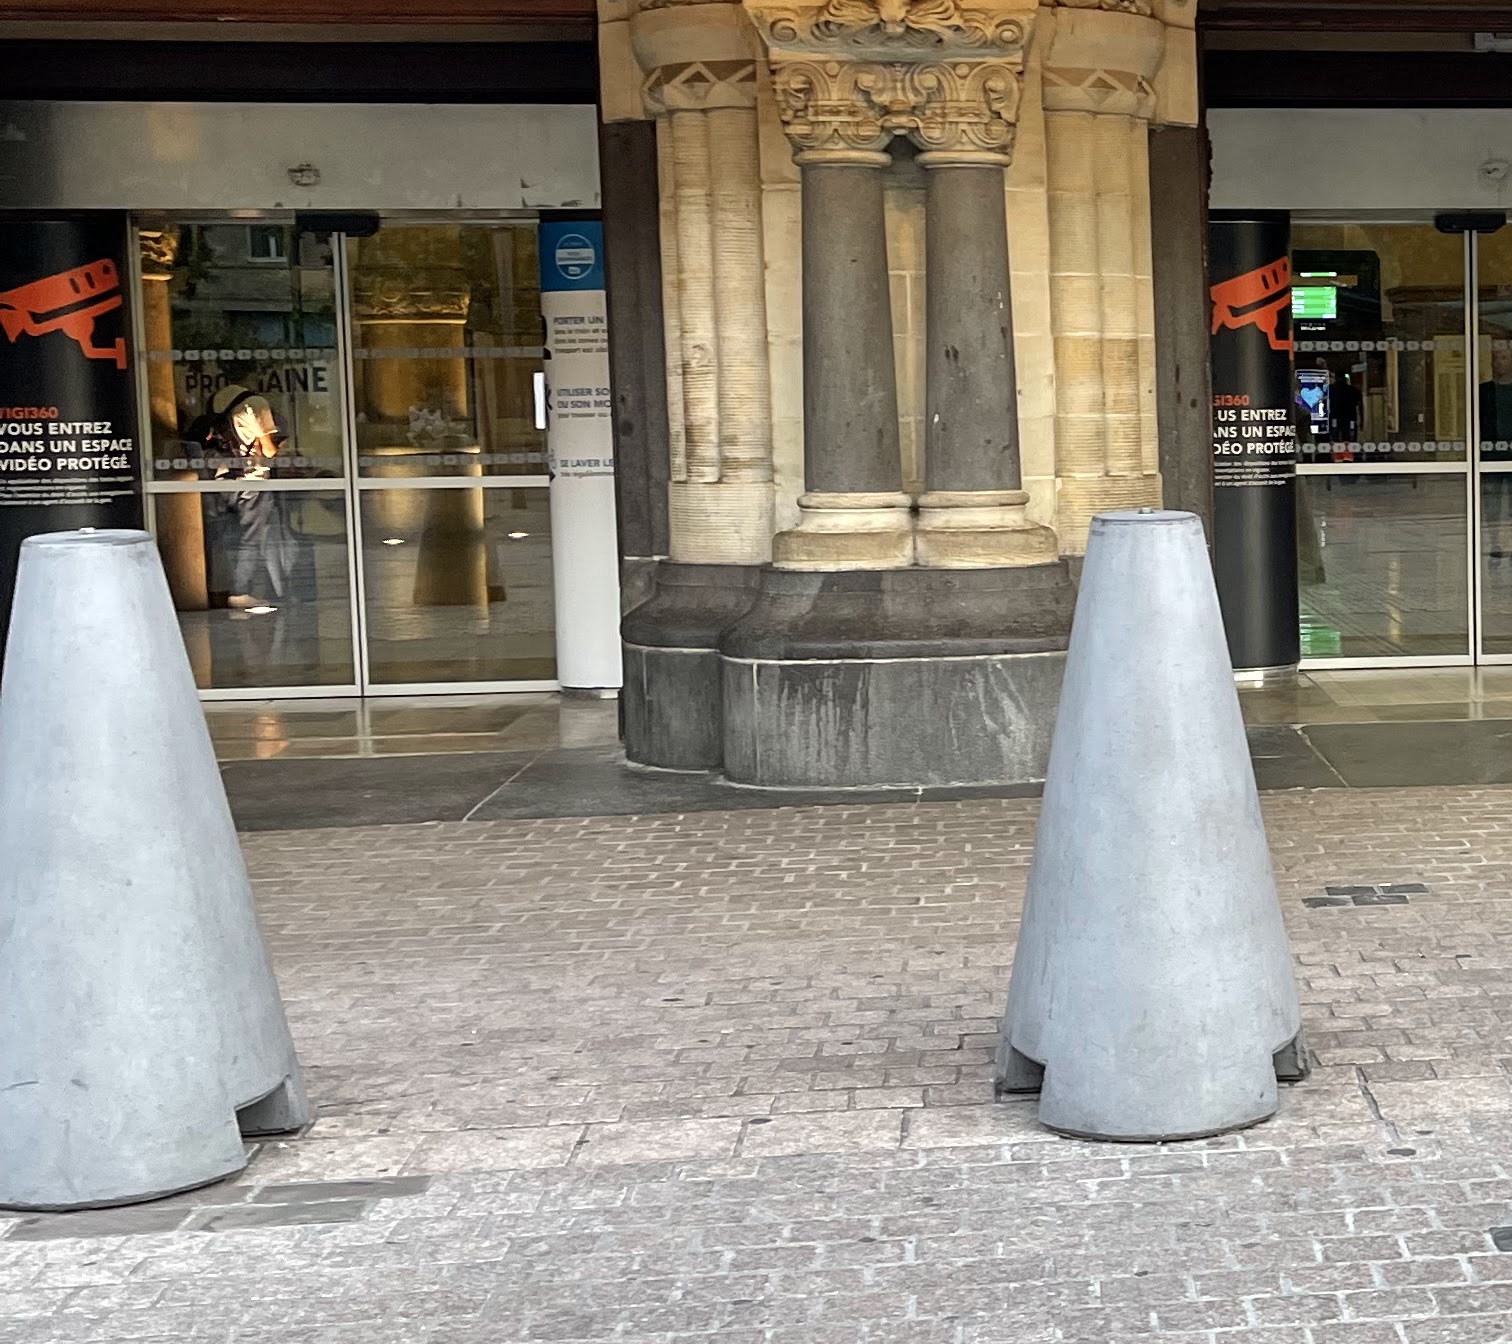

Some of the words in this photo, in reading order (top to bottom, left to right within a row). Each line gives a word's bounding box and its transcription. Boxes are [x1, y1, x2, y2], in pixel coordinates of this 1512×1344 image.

[1241, 409, 1287, 421] ENTREZ
[48, 422, 112, 435] ENTREZ
[1241, 426, 1263, 438] UN
[49, 440, 76, 452] UN
[81, 438, 133, 452] ESPACE
